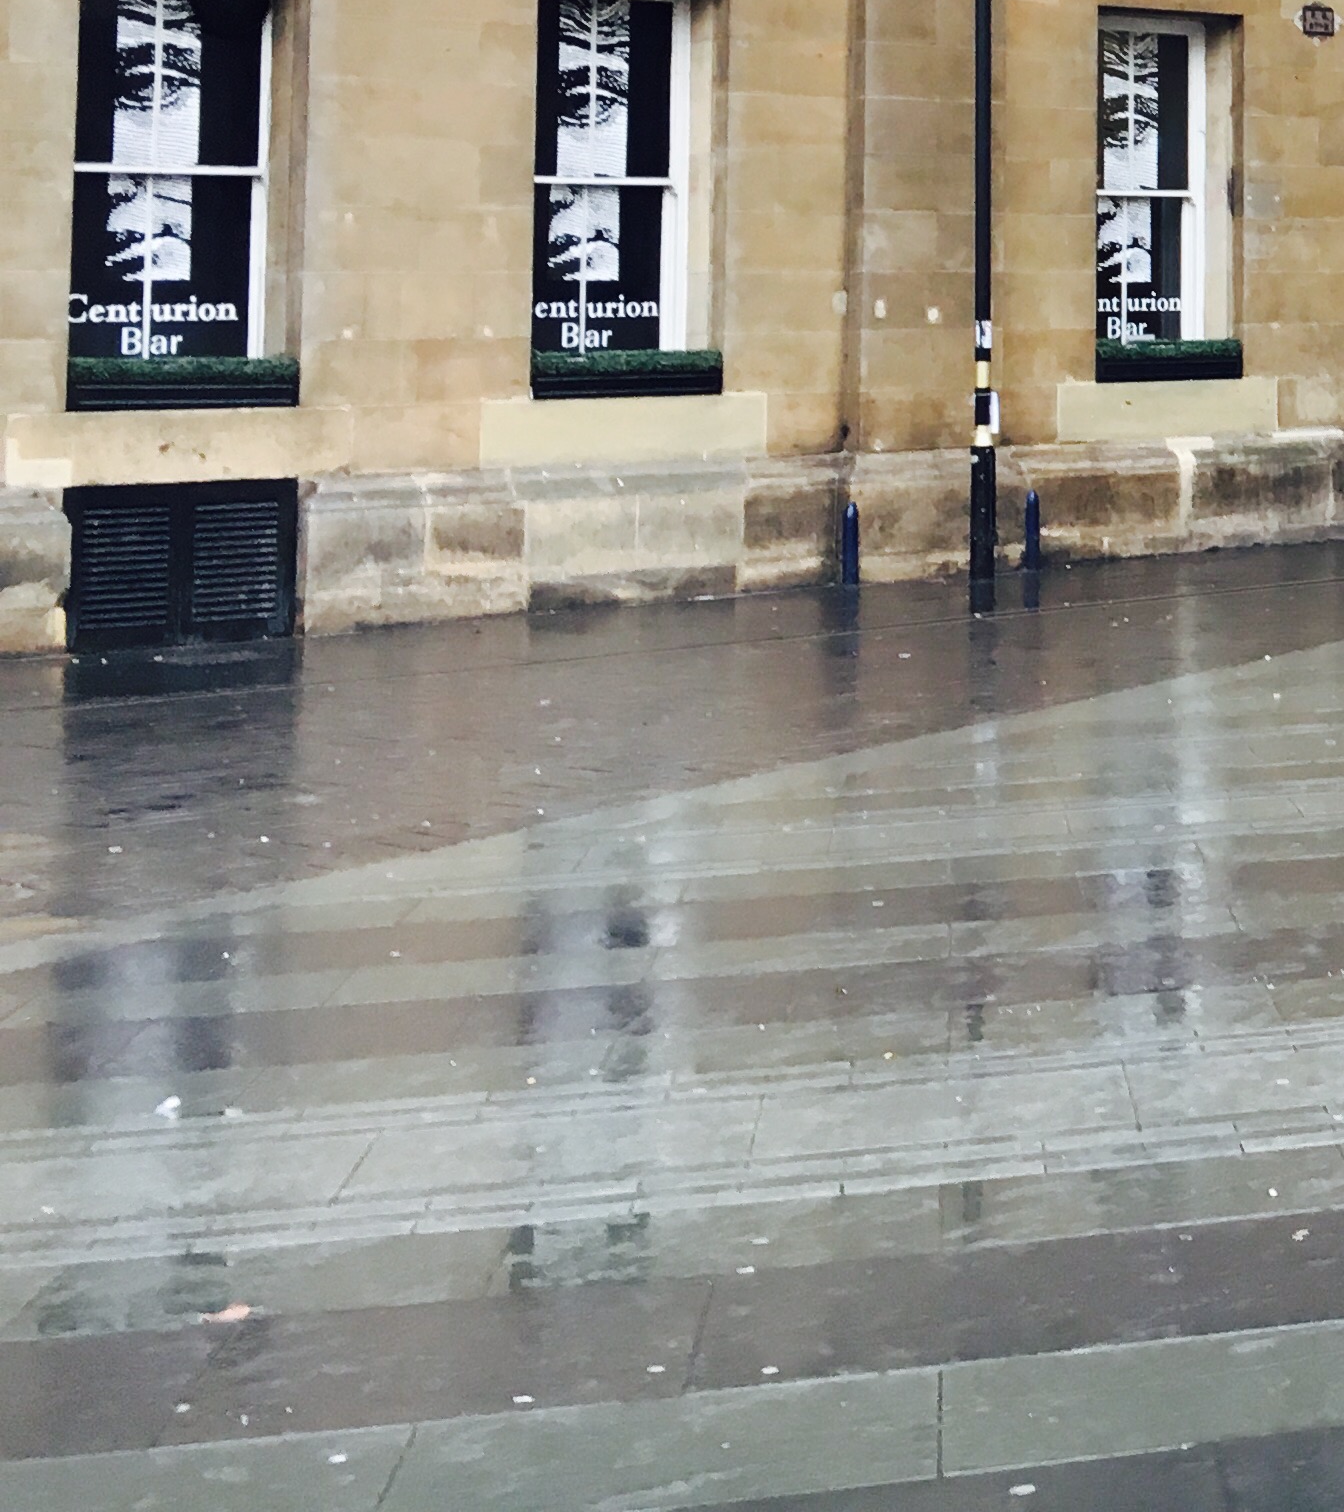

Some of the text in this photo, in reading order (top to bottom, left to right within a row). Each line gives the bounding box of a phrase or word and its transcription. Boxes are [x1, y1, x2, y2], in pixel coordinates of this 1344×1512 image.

[68, 293, 239, 324] Centurion
[534, 293, 659, 319] enturion
[1098, 291, 1181, 312] nturion
[561, 322, 613, 348] Bar
[1107, 316, 1148, 339] Bar
[120, 326, 184, 356] Bar
